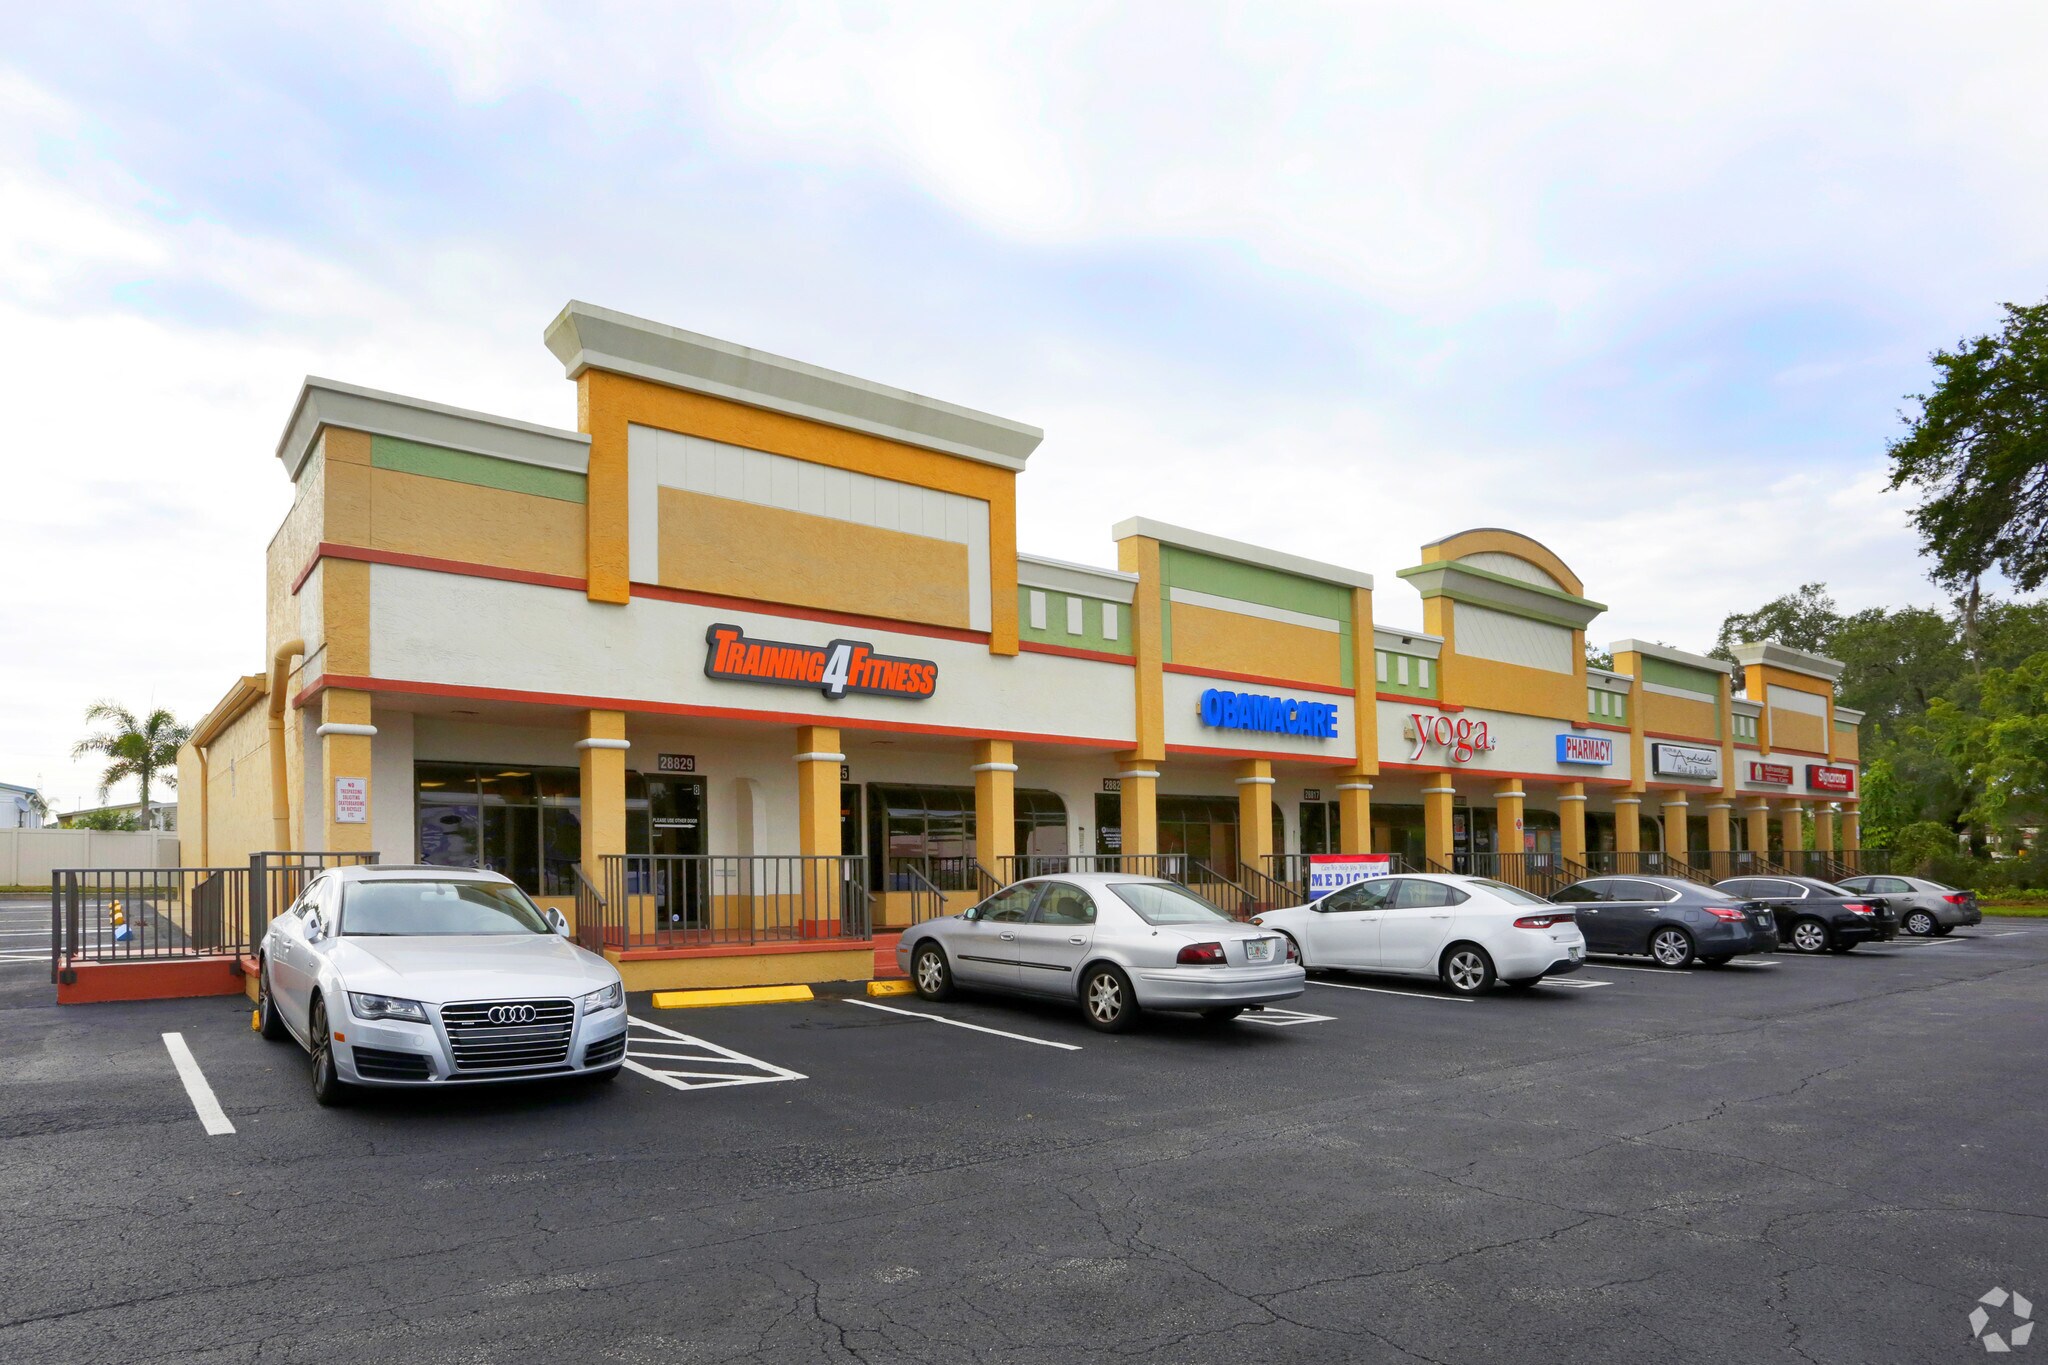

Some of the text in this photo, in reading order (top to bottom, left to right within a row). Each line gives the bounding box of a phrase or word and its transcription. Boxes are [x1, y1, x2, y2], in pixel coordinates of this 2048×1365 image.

[1201, 688, 1338, 738] OBAMACARE
[1410, 713, 1491, 763] yoga
[1566, 738, 1610, 761] PHARMACY
[660, 757, 693, 770] 28829
[1105, 781, 1120, 790] 2882
[1311, 872, 1387, 887] MEDIC
